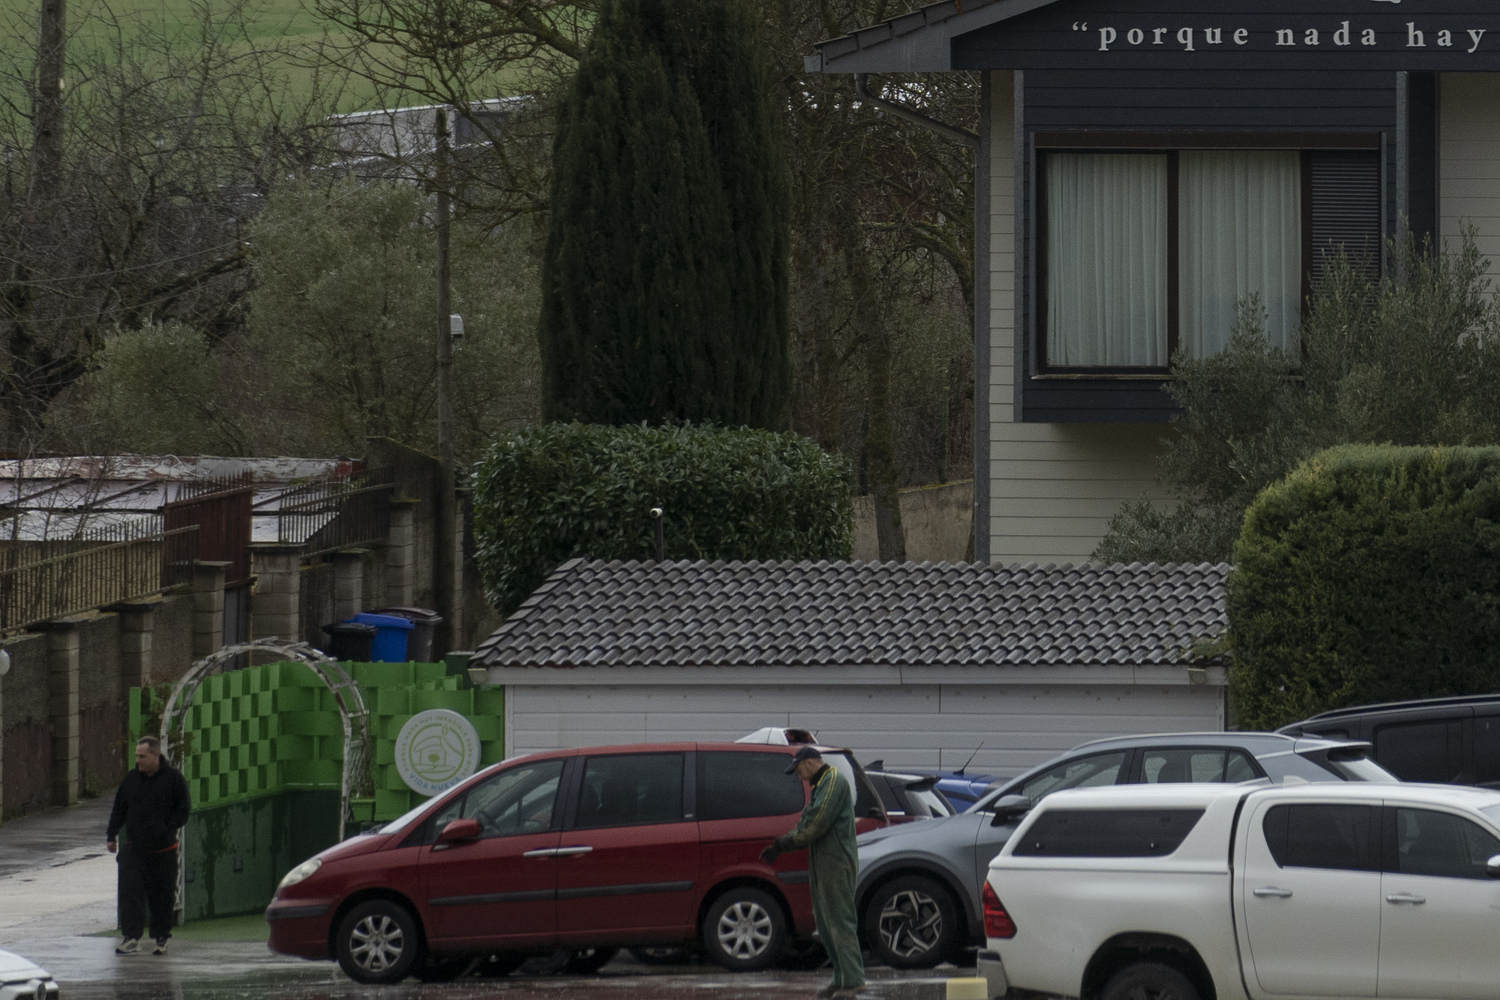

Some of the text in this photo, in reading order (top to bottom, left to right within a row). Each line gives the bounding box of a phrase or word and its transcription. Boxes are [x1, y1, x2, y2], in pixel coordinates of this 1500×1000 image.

[1275, 20, 1377, 46] nada
[1406, 21, 1487, 54] hay
[410, 773, 428, 789] VIDA
